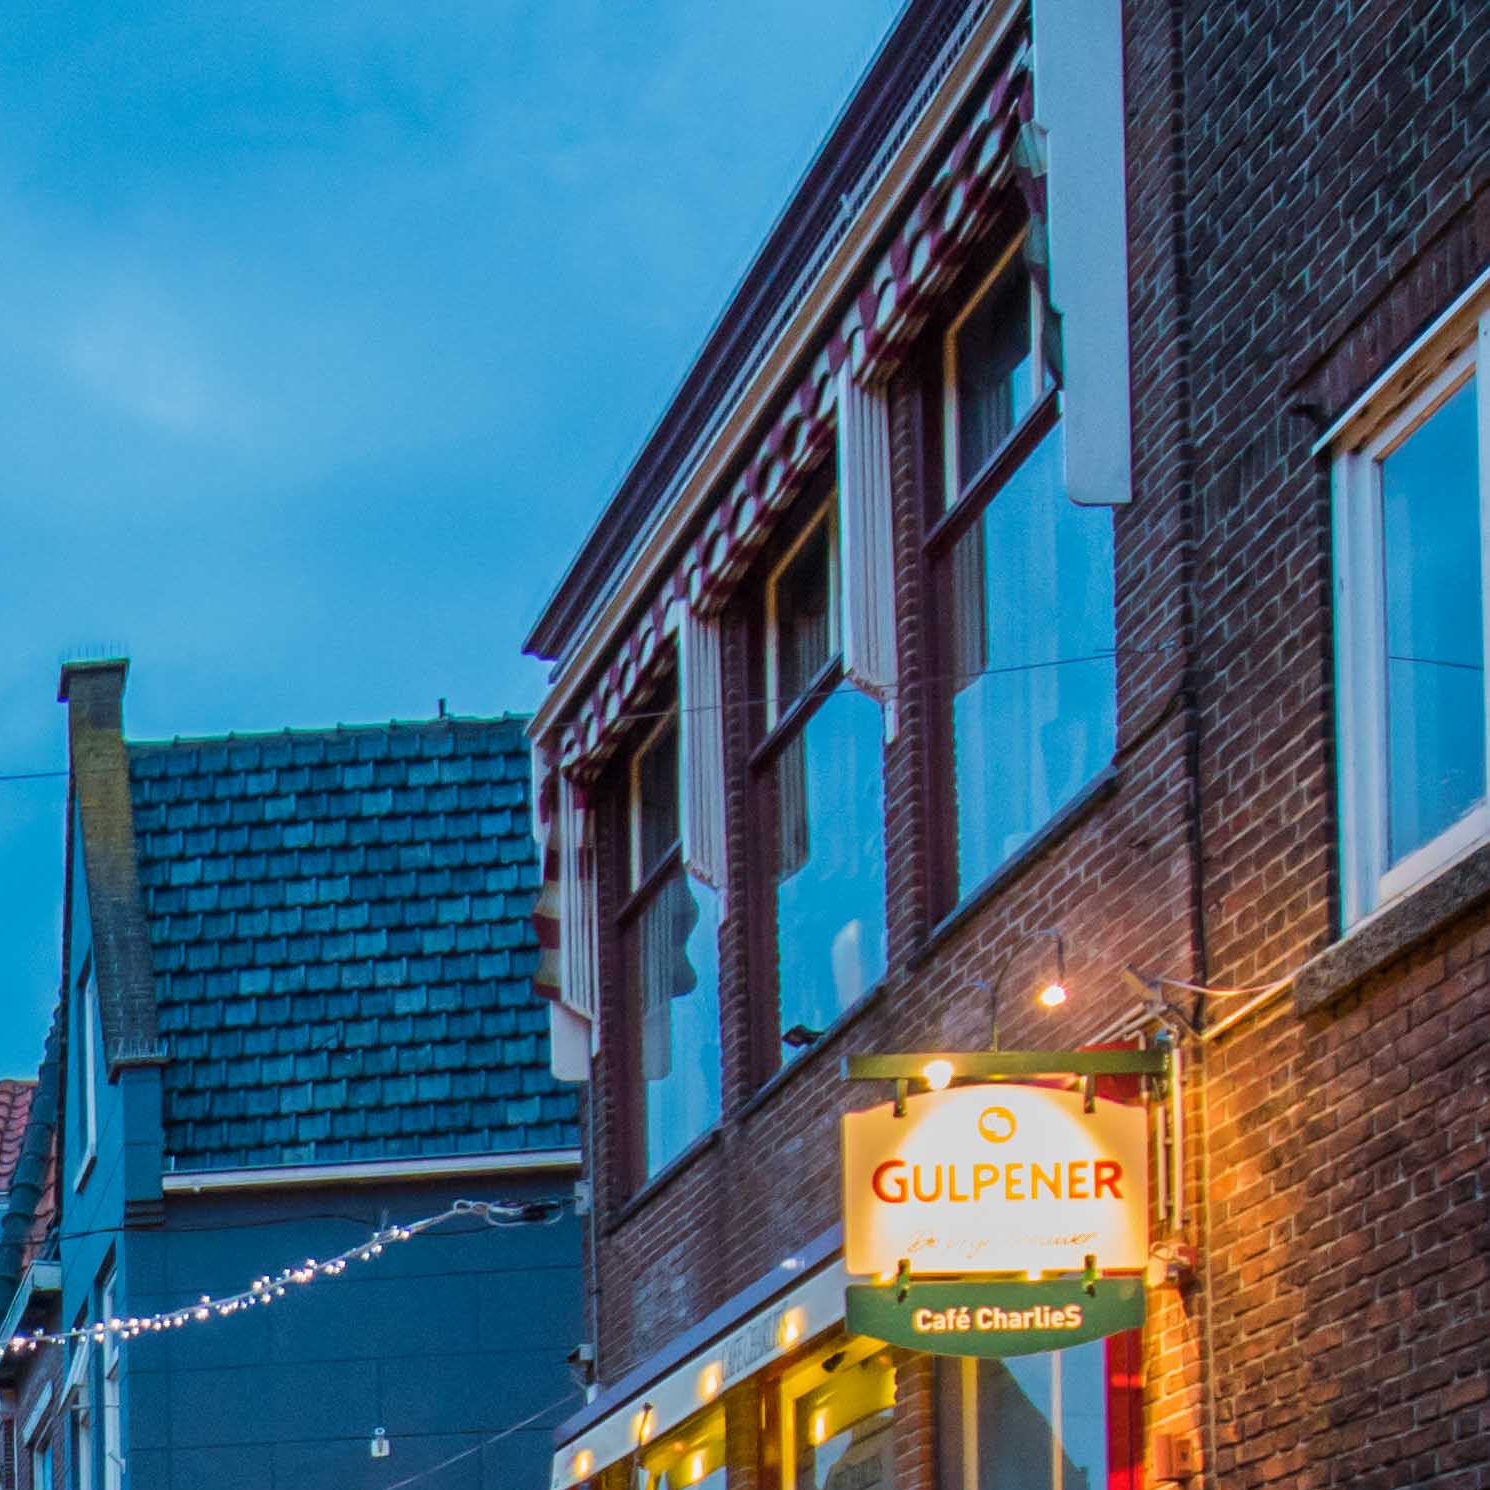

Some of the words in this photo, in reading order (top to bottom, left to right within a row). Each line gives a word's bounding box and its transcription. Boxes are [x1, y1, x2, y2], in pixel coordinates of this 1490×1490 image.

[871, 1158, 1125, 1204] GULPENER
[914, 1307, 971, 1332] Café
[975, 1304, 1084, 1329] CharlieS
